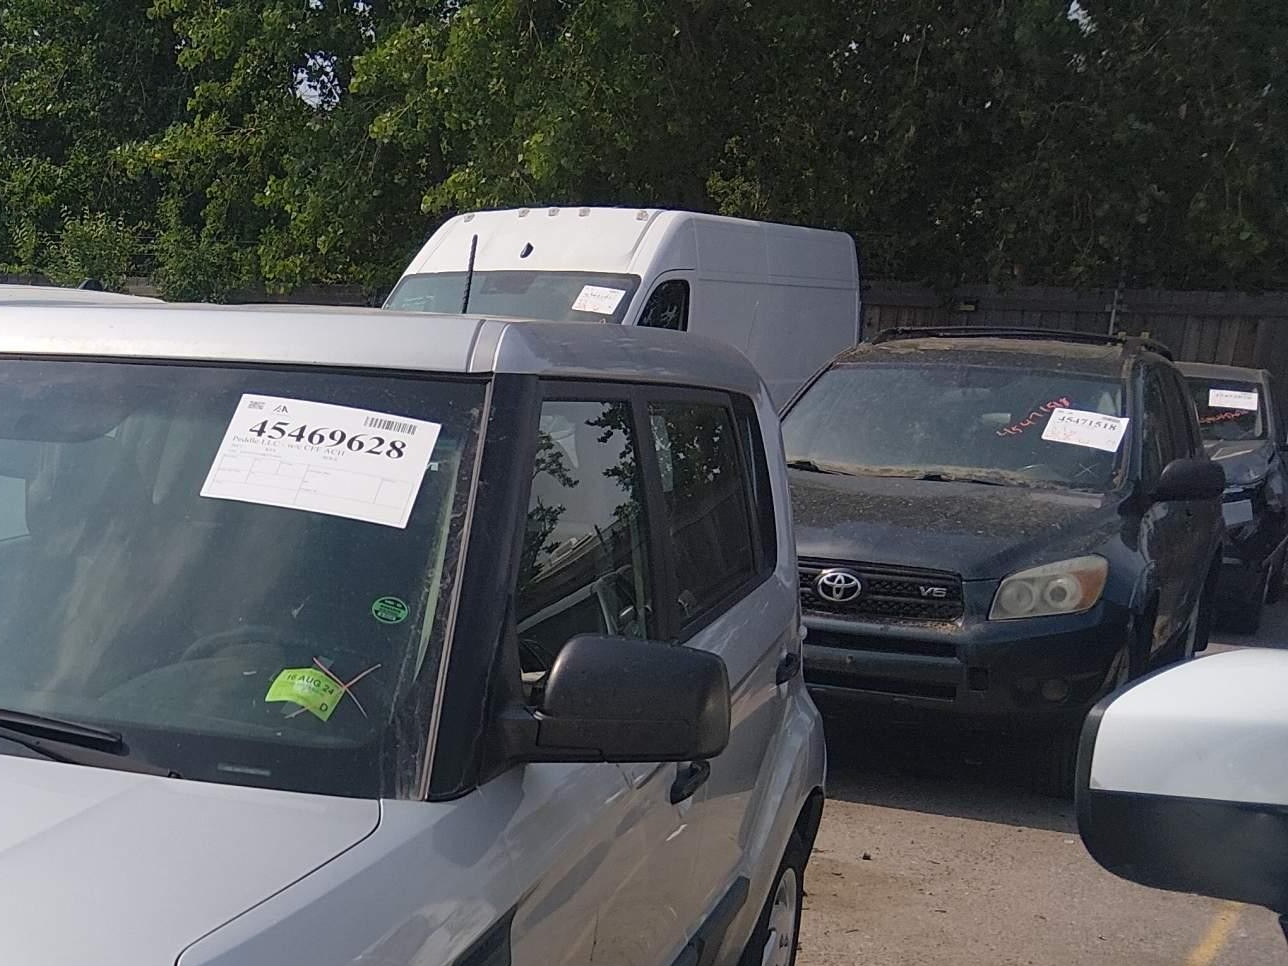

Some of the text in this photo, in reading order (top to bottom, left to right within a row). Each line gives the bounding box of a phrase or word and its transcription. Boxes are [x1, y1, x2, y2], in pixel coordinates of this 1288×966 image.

[248, 419, 407, 460] 45469628
[919, 586, 948, 598] V6
[298, 675, 321, 688] AUG
